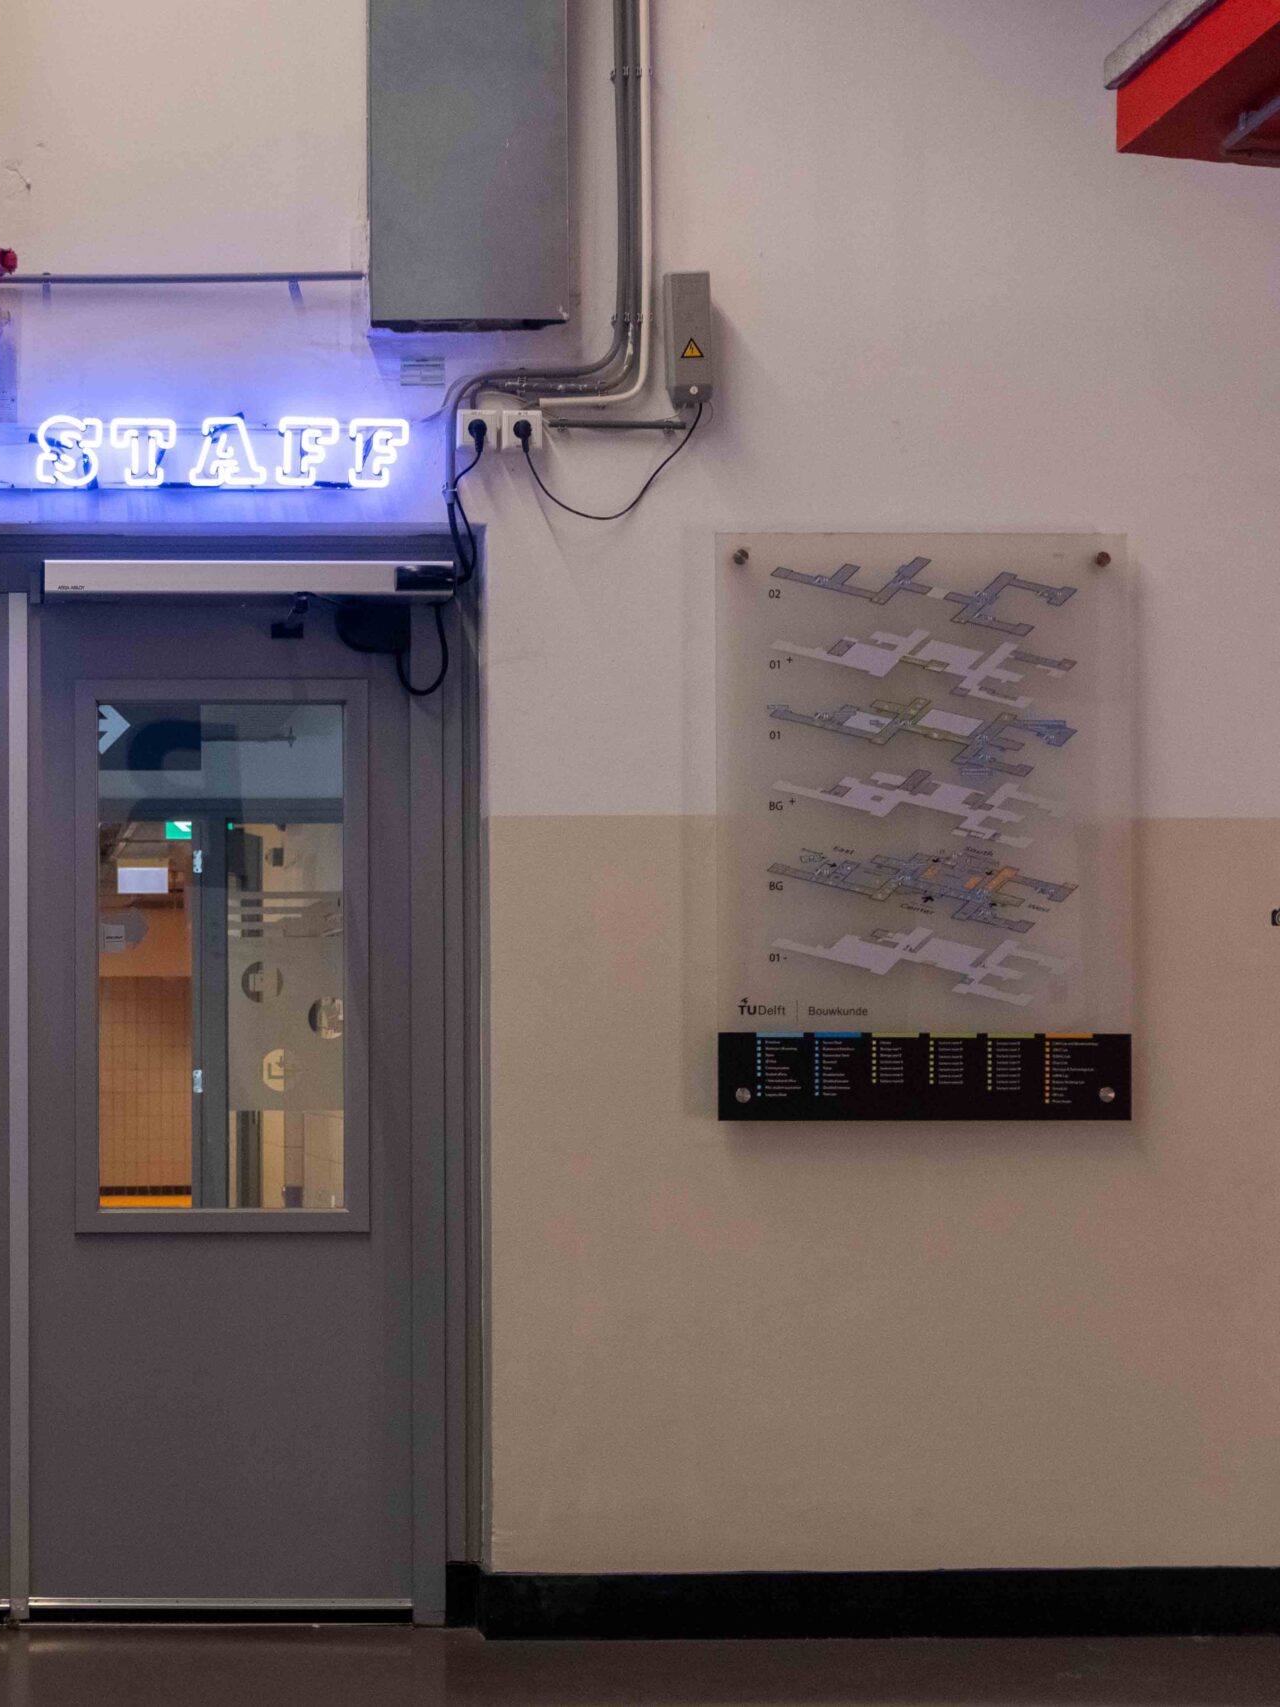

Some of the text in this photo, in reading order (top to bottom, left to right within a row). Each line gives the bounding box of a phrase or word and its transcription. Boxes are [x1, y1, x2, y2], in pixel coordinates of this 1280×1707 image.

[35, 414, 410, 487] STAFF
[768, 588, 781, 599] 02
[769, 659, 780, 669] 01
[769, 730, 781, 740] 01
[769, 801, 783, 811] BG
[769, 881, 784, 891] BG
[769, 953, 780, 962] 01
[808, 1006, 869, 1017] Bouwkunde
